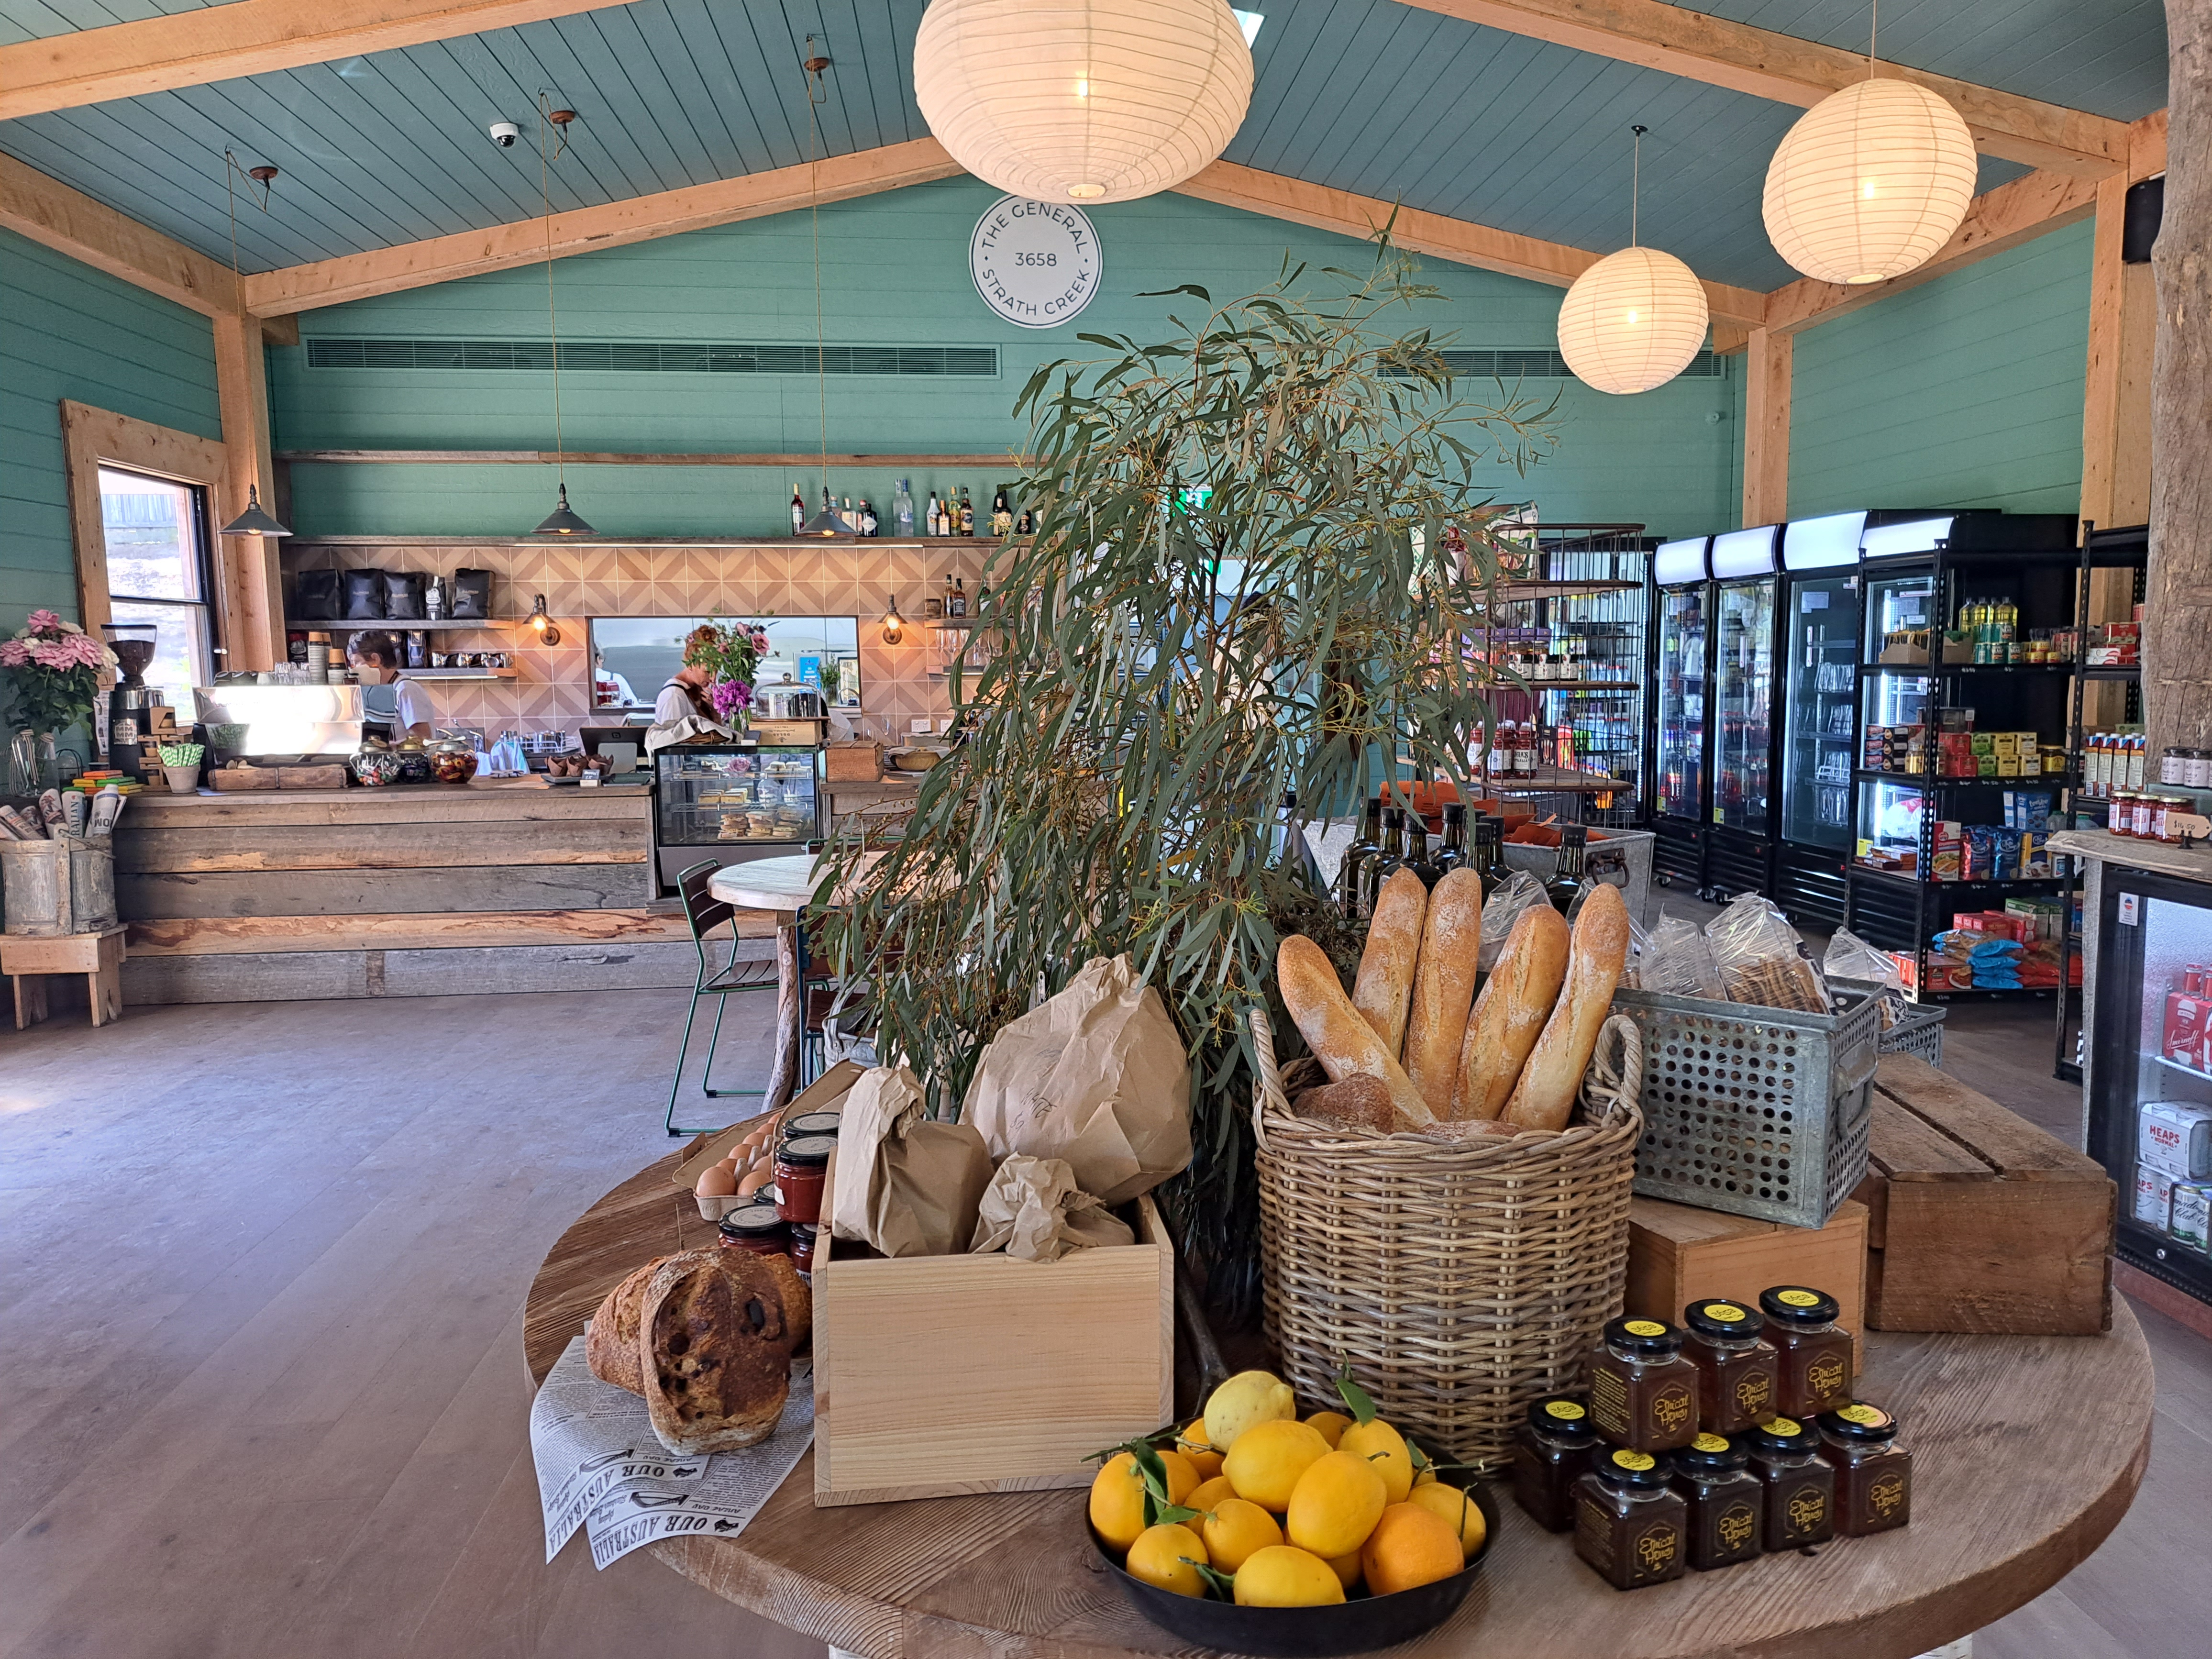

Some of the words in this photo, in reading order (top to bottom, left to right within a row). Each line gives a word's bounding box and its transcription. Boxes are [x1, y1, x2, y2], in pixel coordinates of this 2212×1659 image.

[982, 213, 1010, 248] THE
[1012, 202, 1087, 254] GENERAL
[1015, 253, 1057, 266] 3658
[982, 269, 1037, 316] STRATH
[1044, 269, 1090, 314] CREEK
[2167, 1029, 2200, 1050] Smirnoff
[2150, 1125, 2180, 1144] HEAPS
[2154, 1137, 2175, 1149] NORMAL
[1809, 1362, 1843, 1382] Ethical
[1737, 1377, 1769, 1399] Ethical
[1811, 1374, 1842, 1393] Honey
[1654, 1394, 1689, 1416] Ethical
[1740, 1390, 1768, 1410] Honey
[1657, 1408, 1687, 1427] Honey
[621, 1465, 665, 1477] OUR
[1871, 1479, 1902, 1501] Ethical
[549, 1469, 614, 1553] AUSTRALIA
[1789, 1495, 1825, 1516] Ethical
[1873, 1493, 1901, 1511] Honey
[664, 1516, 708, 1532] OUR
[1719, 1511, 1753, 1534] Ethical
[1792, 1509, 1823, 1526] Honey
[593, 1516, 662, 1566] AUSTRALIA
[1639, 1533, 1676, 1554] Ethical
[1723, 1524, 1752, 1544] Honey
[1641, 1547, 1674, 1566] Honey
